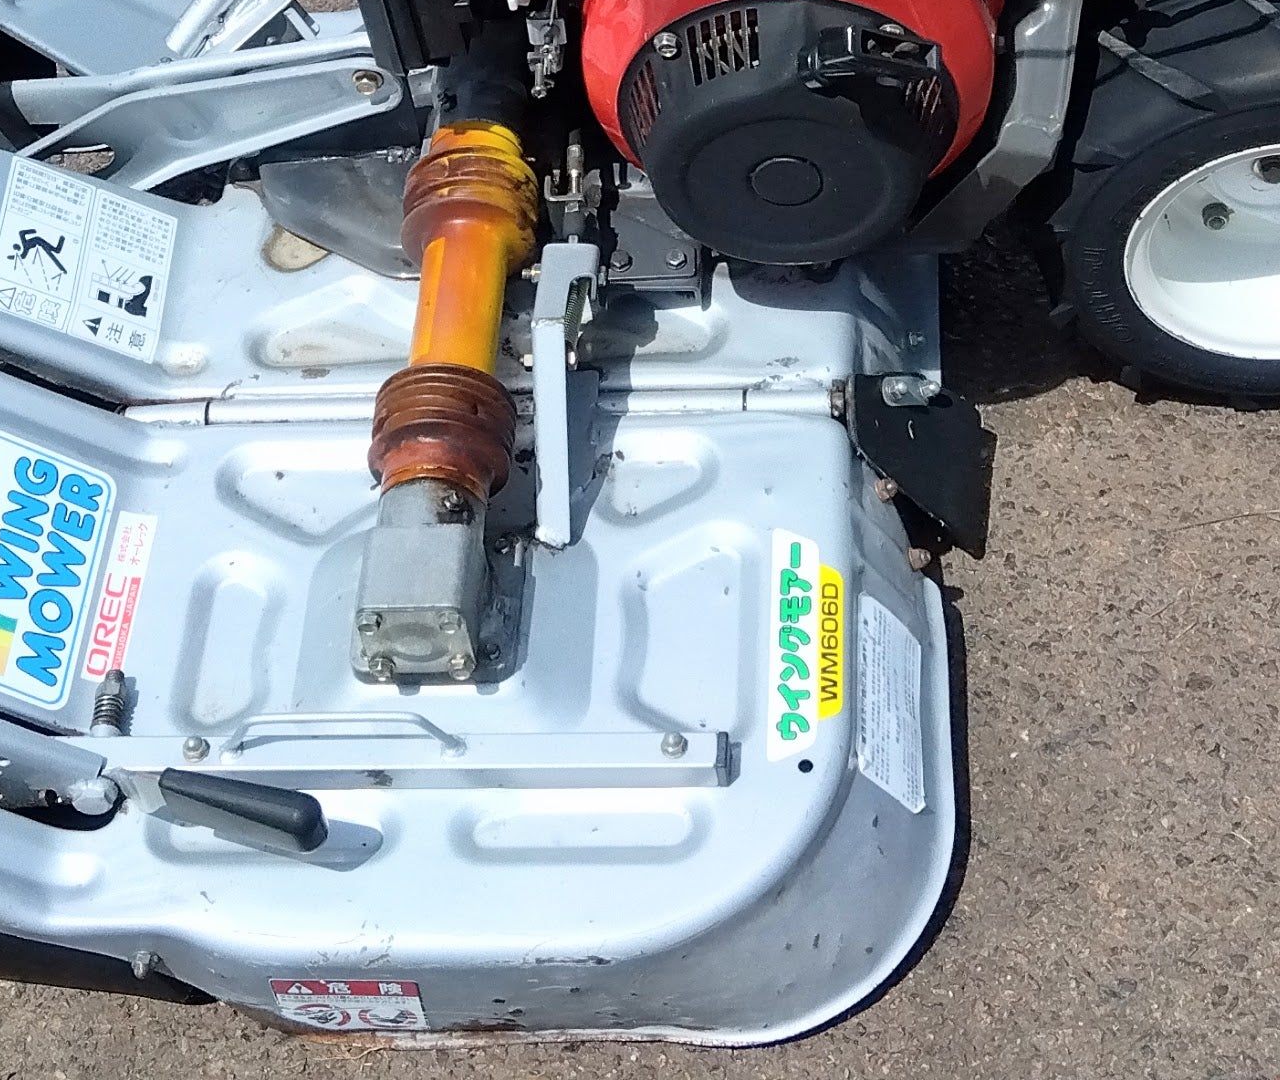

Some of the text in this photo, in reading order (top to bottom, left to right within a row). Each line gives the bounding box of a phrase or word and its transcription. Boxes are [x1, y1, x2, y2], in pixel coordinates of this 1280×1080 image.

[105, 322, 147, 352] 注意
[16, 474, 103, 687] MOWER
[86, 573, 128, 677] OREC
[125, 583, 138, 617] JAPAN
[776, 542, 812, 740] ウイングモアー
[820, 583, 838, 702] WM606D
[327, 982, 403, 995] 危険
